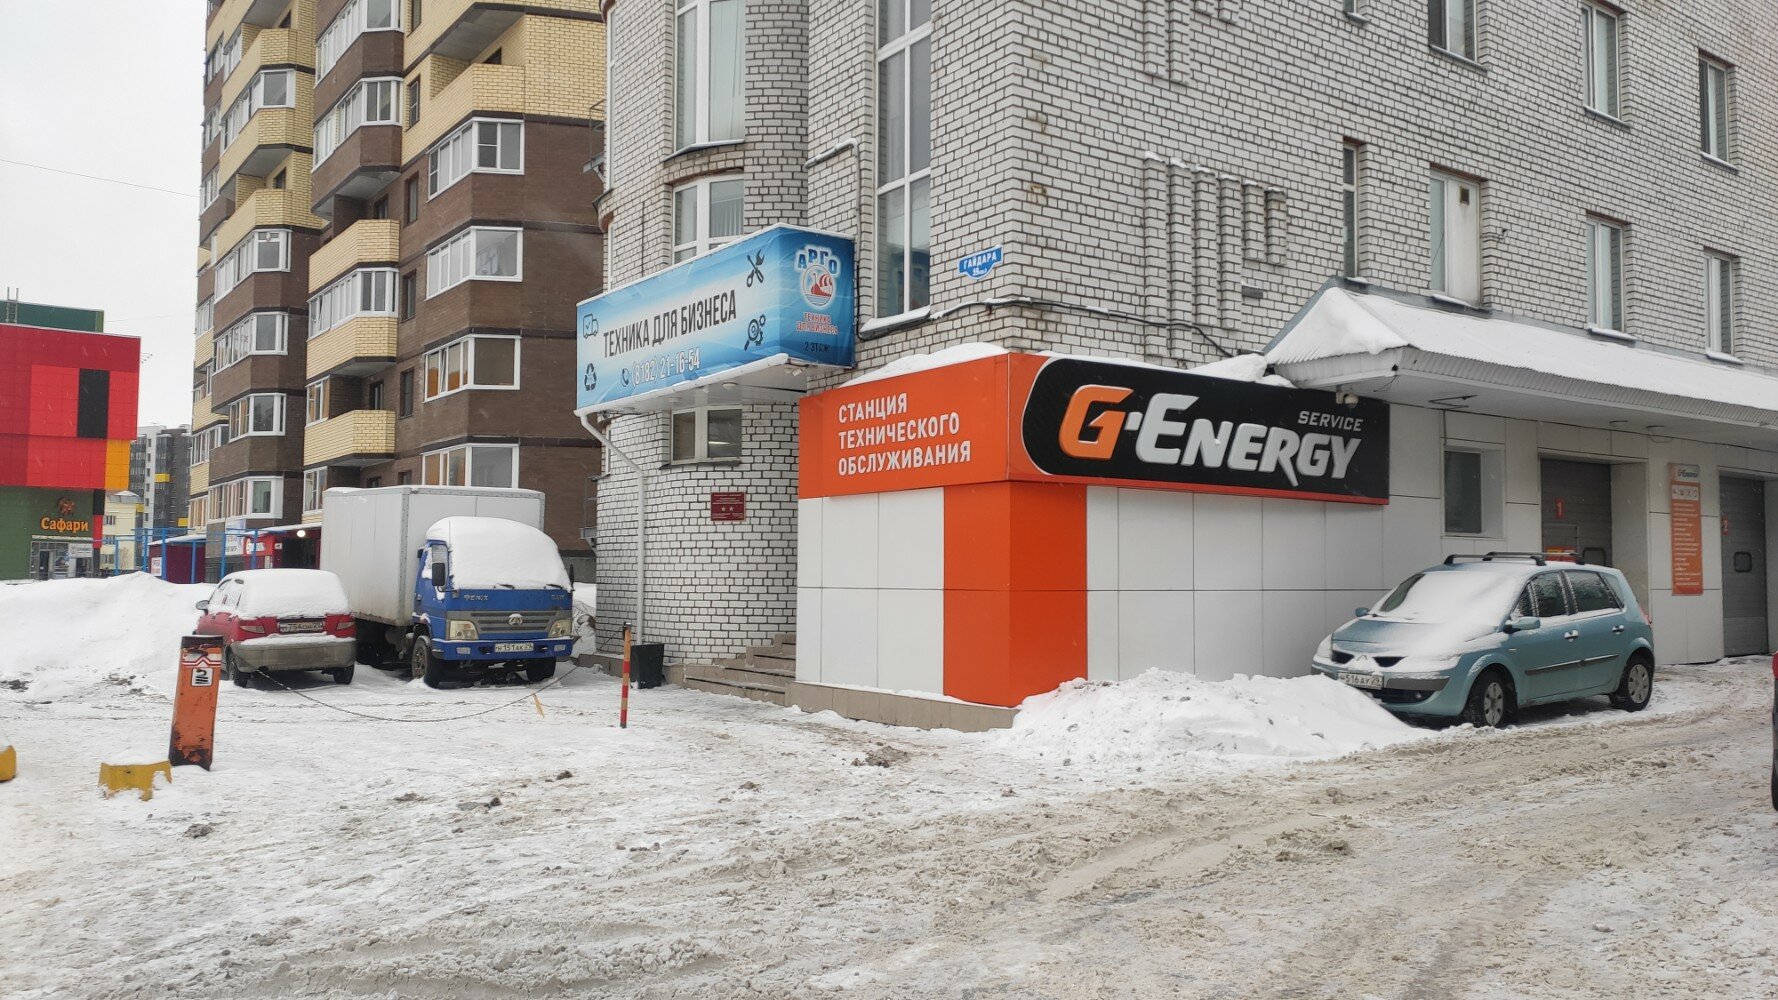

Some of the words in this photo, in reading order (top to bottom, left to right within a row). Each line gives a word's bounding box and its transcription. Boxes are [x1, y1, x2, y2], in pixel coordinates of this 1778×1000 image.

[797, 248, 838, 275] АРГО
[963, 251, 997, 270] ГАЙДАРА
[603, 318, 650, 358] ТЕХНИКА
[652, 309, 679, 348] ДЛЯ
[681, 289, 737, 336] БИЗНЕСА
[838, 392, 908, 424] СТАНЦИЯ
[1297, 410, 1364, 432] SERVICE
[838, 411, 961, 450] ТЕХНИЧЕСКОГО
[838, 440, 971, 476] ОБСЛУЖИВАНИЯ
[40, 517, 89, 533] Сафари
